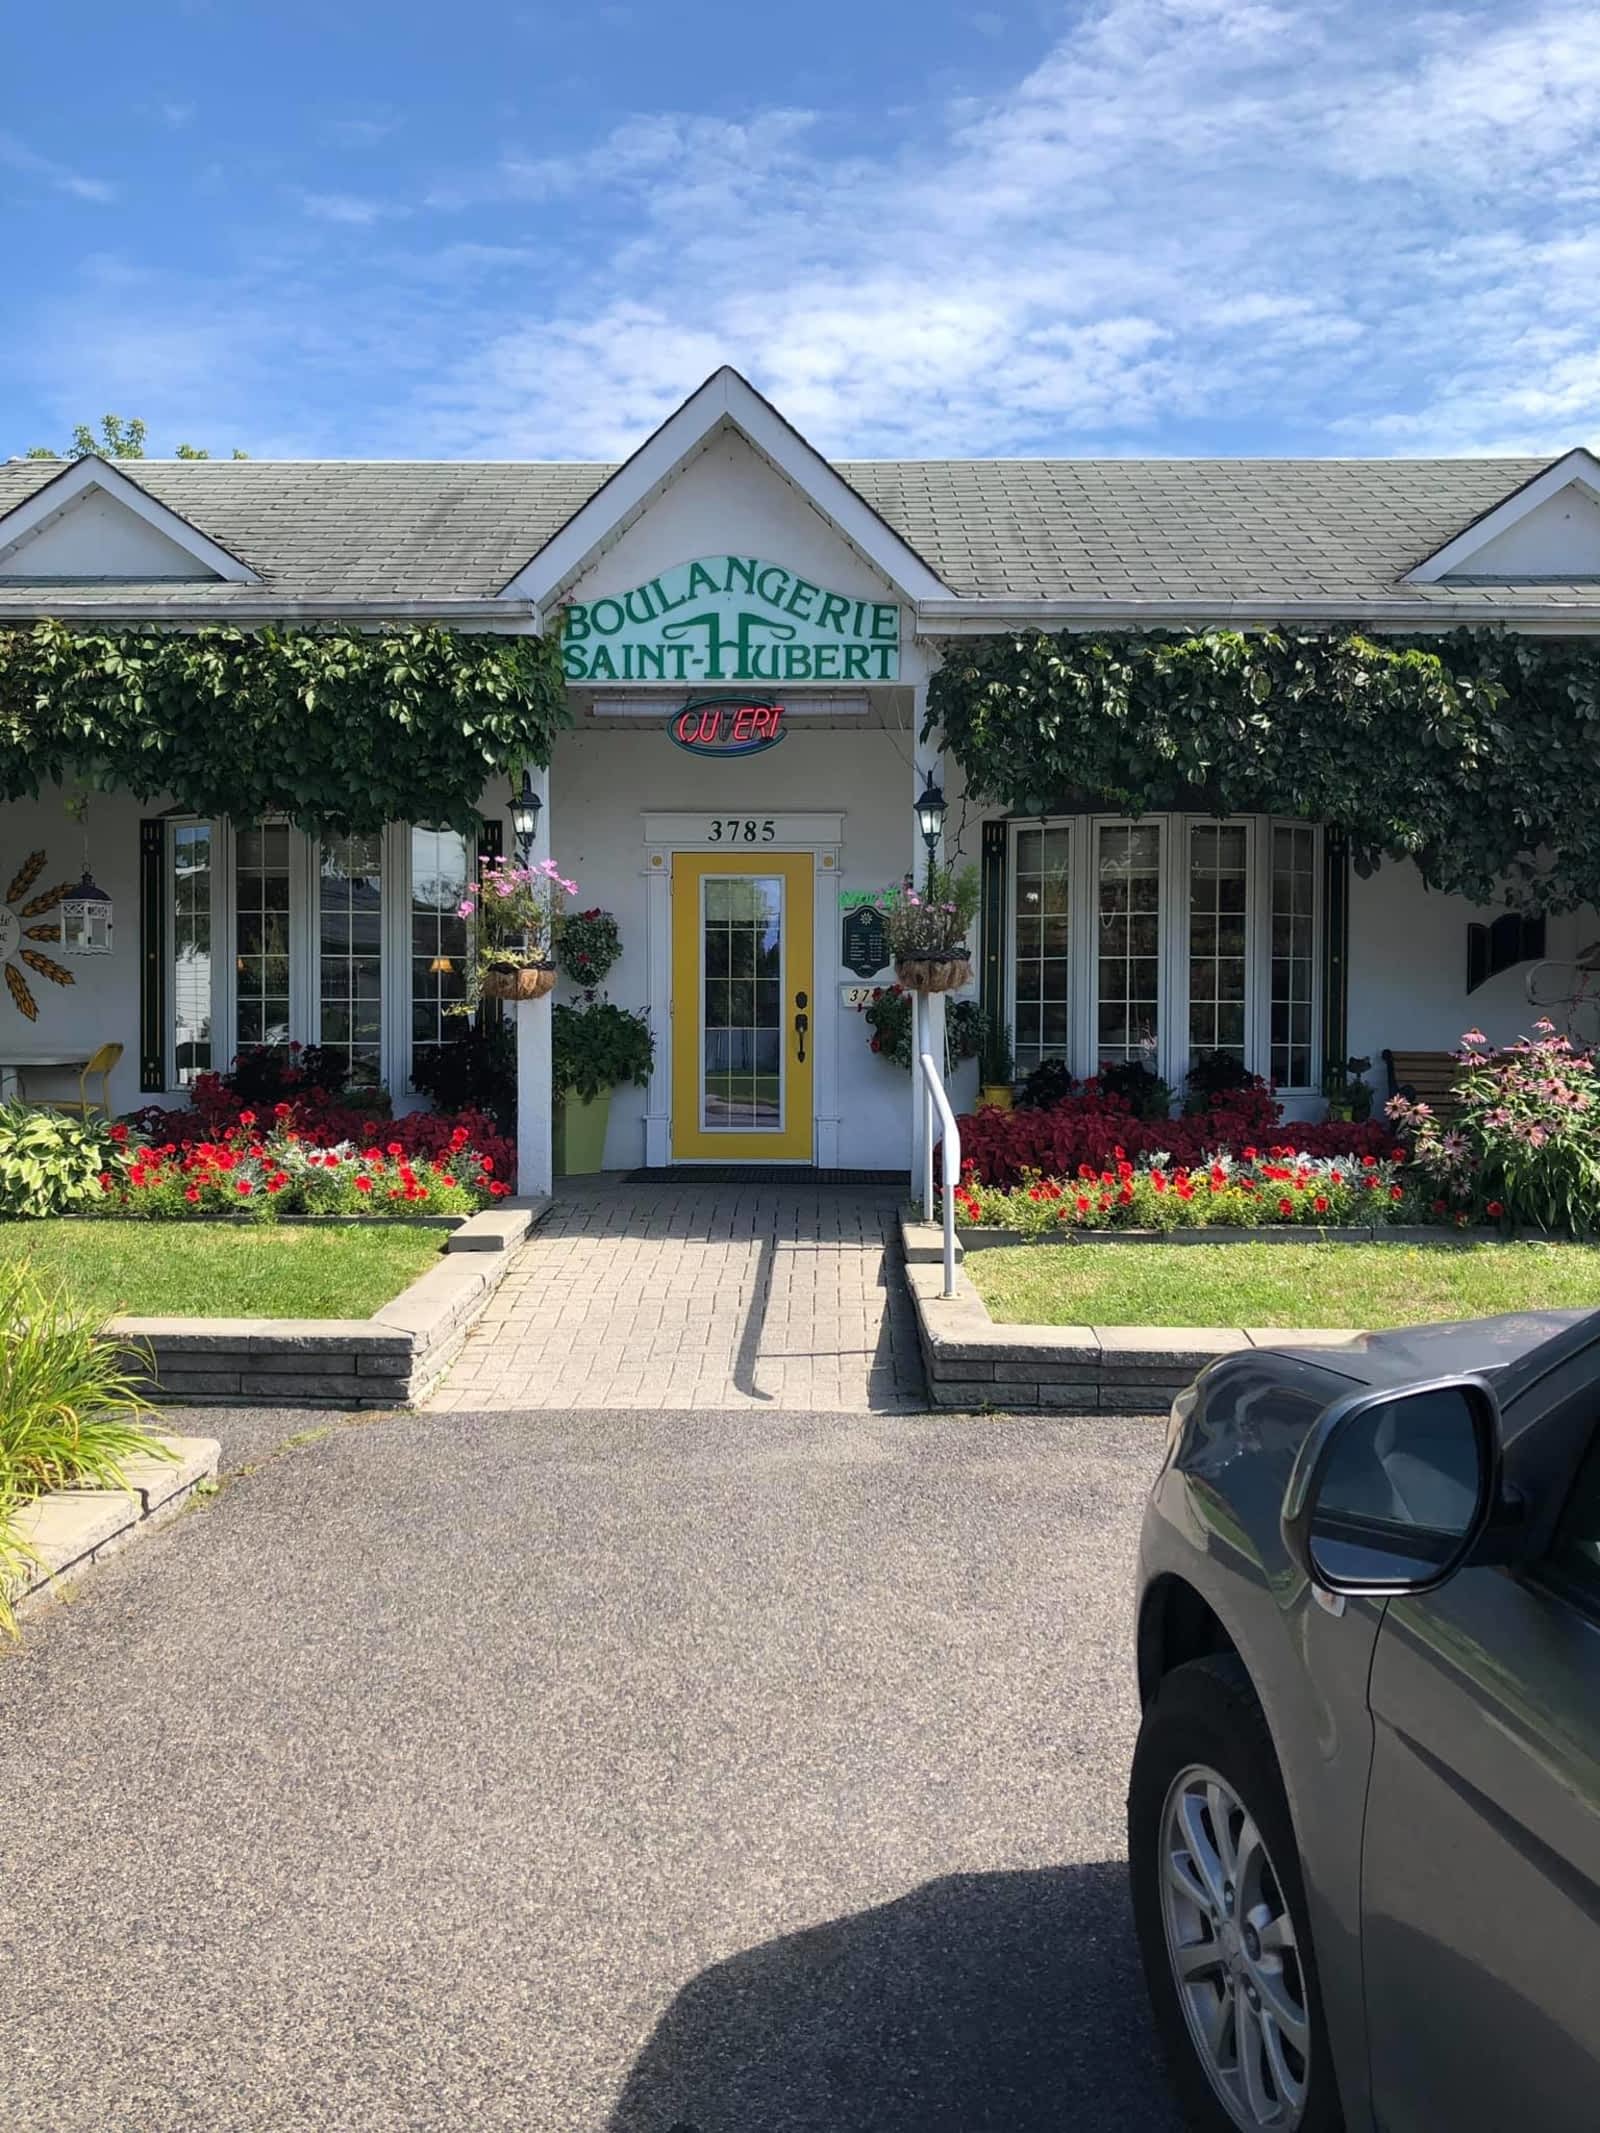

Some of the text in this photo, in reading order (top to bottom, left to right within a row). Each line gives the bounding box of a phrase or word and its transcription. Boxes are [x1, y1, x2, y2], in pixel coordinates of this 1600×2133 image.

[564, 556, 898, 640] BOULANGERIE
[564, 613, 898, 680] SAINT-HUBERT
[678, 707, 785, 742] OUVERT
[708, 820, 775, 842] 3785
[850, 989, 870, 1002] 37
